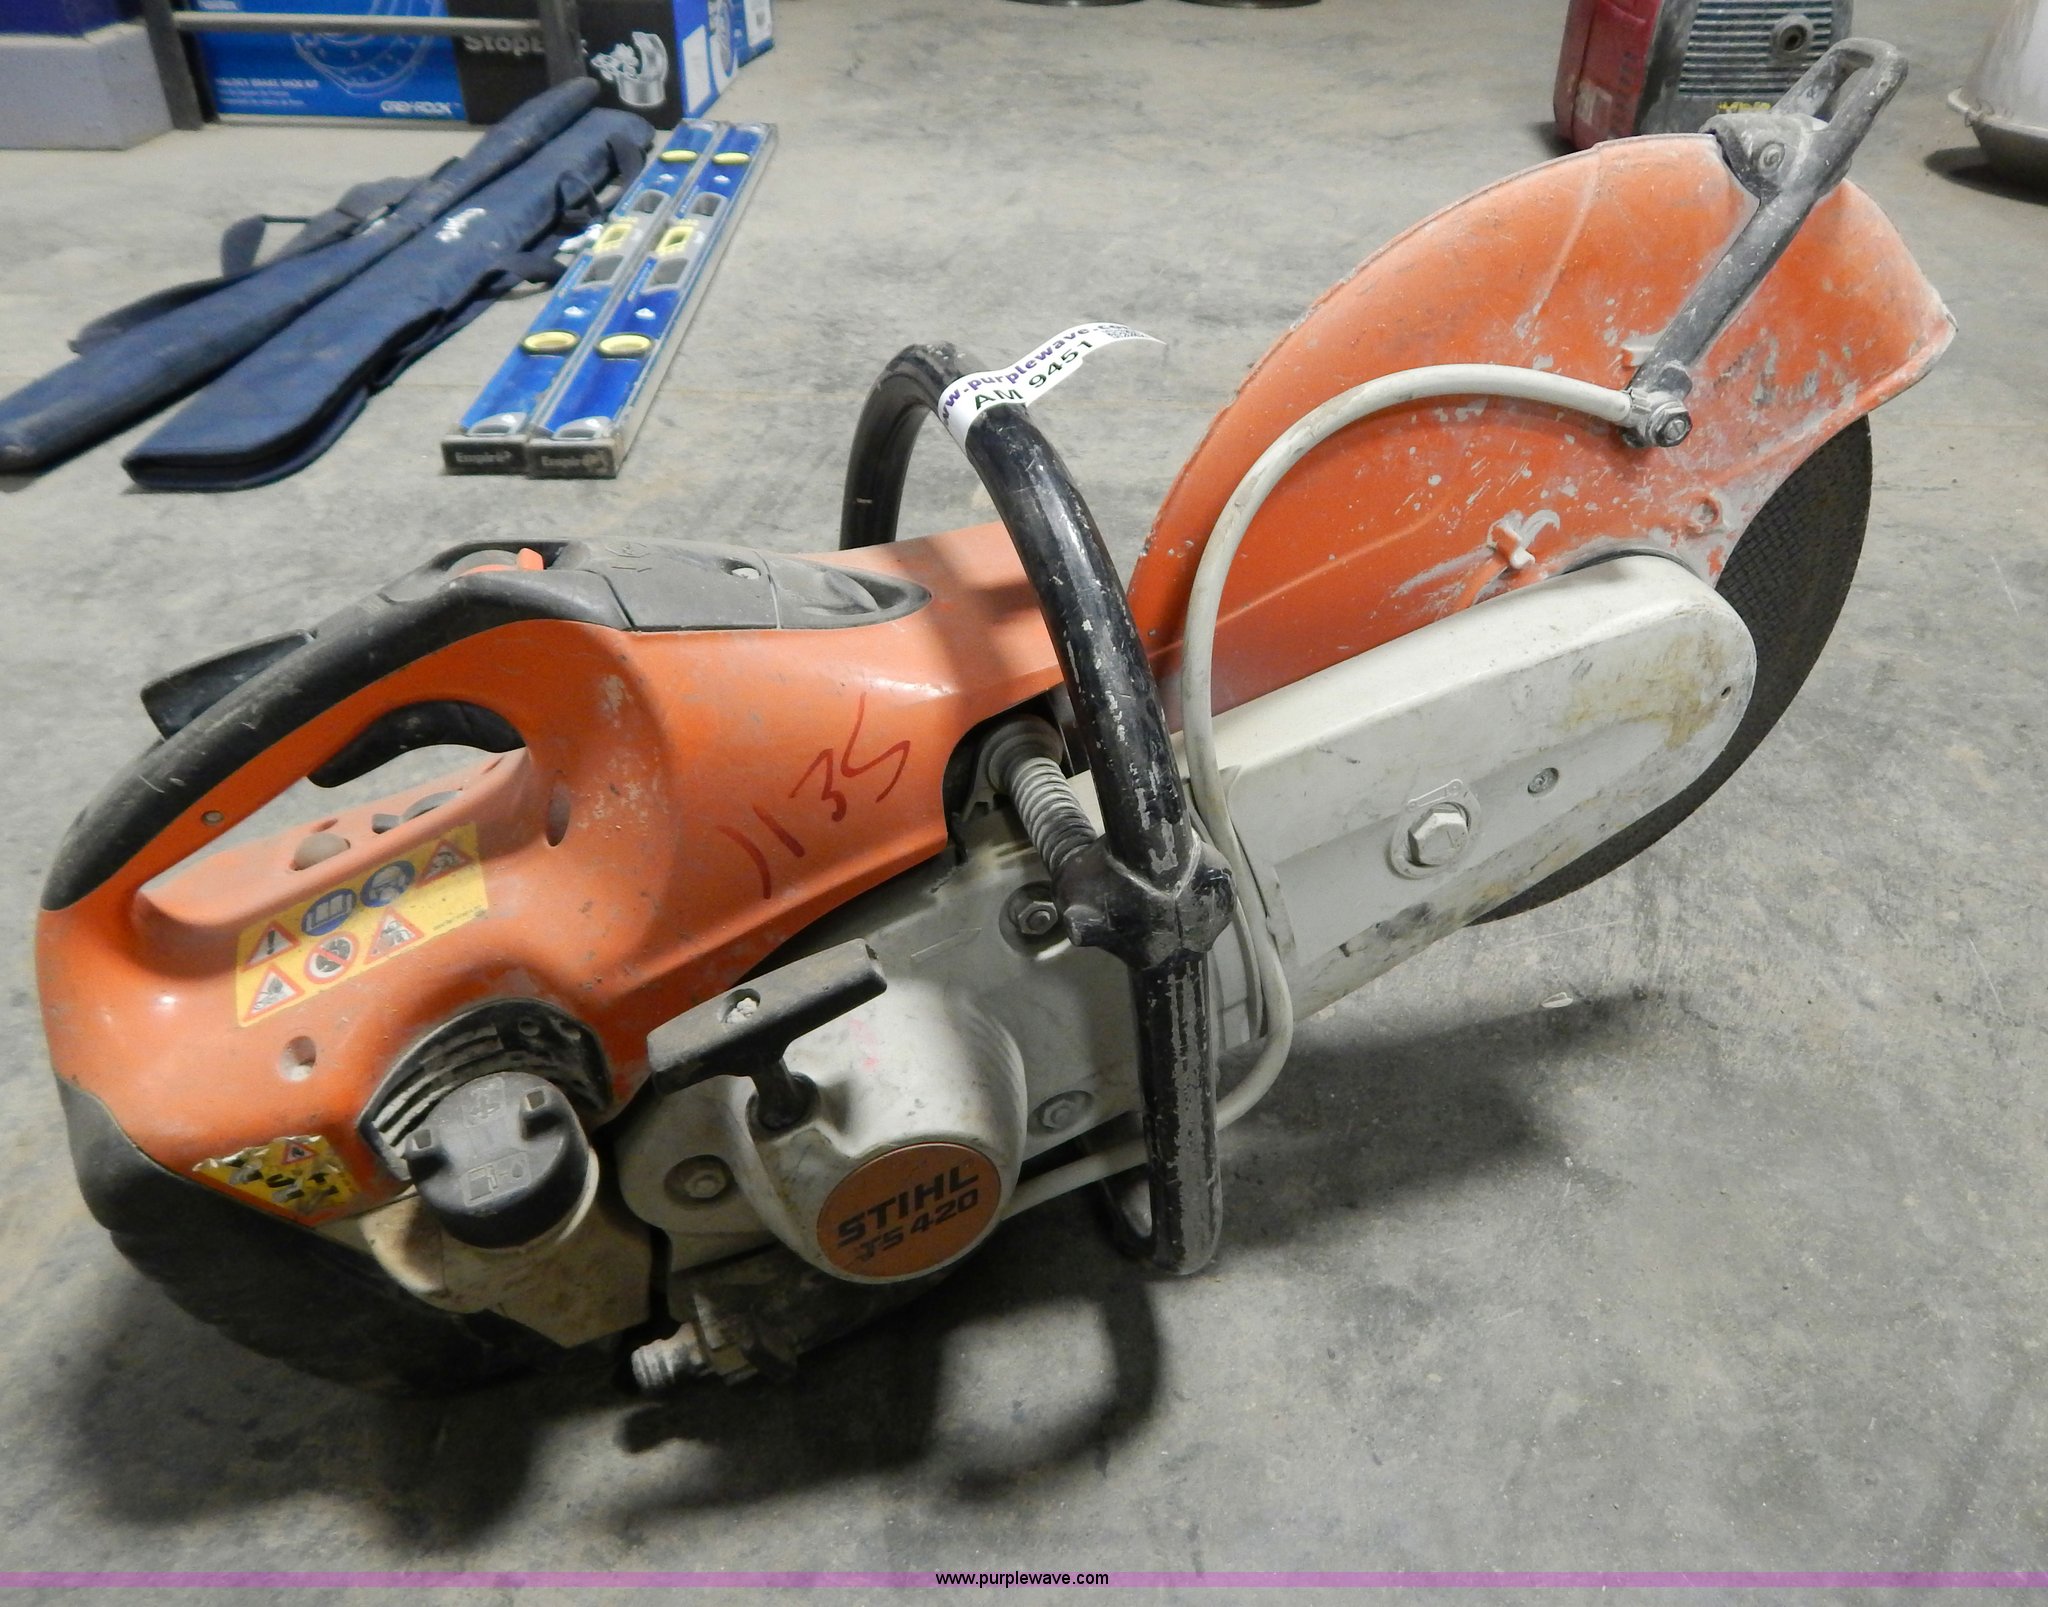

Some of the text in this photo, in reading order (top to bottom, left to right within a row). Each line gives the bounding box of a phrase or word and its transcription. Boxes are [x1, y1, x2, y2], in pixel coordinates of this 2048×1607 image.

[973, 340, 1093, 411] AM 9451
[837, 1166, 980, 1249] STIHL
[911, 1188, 980, 1235] 420
